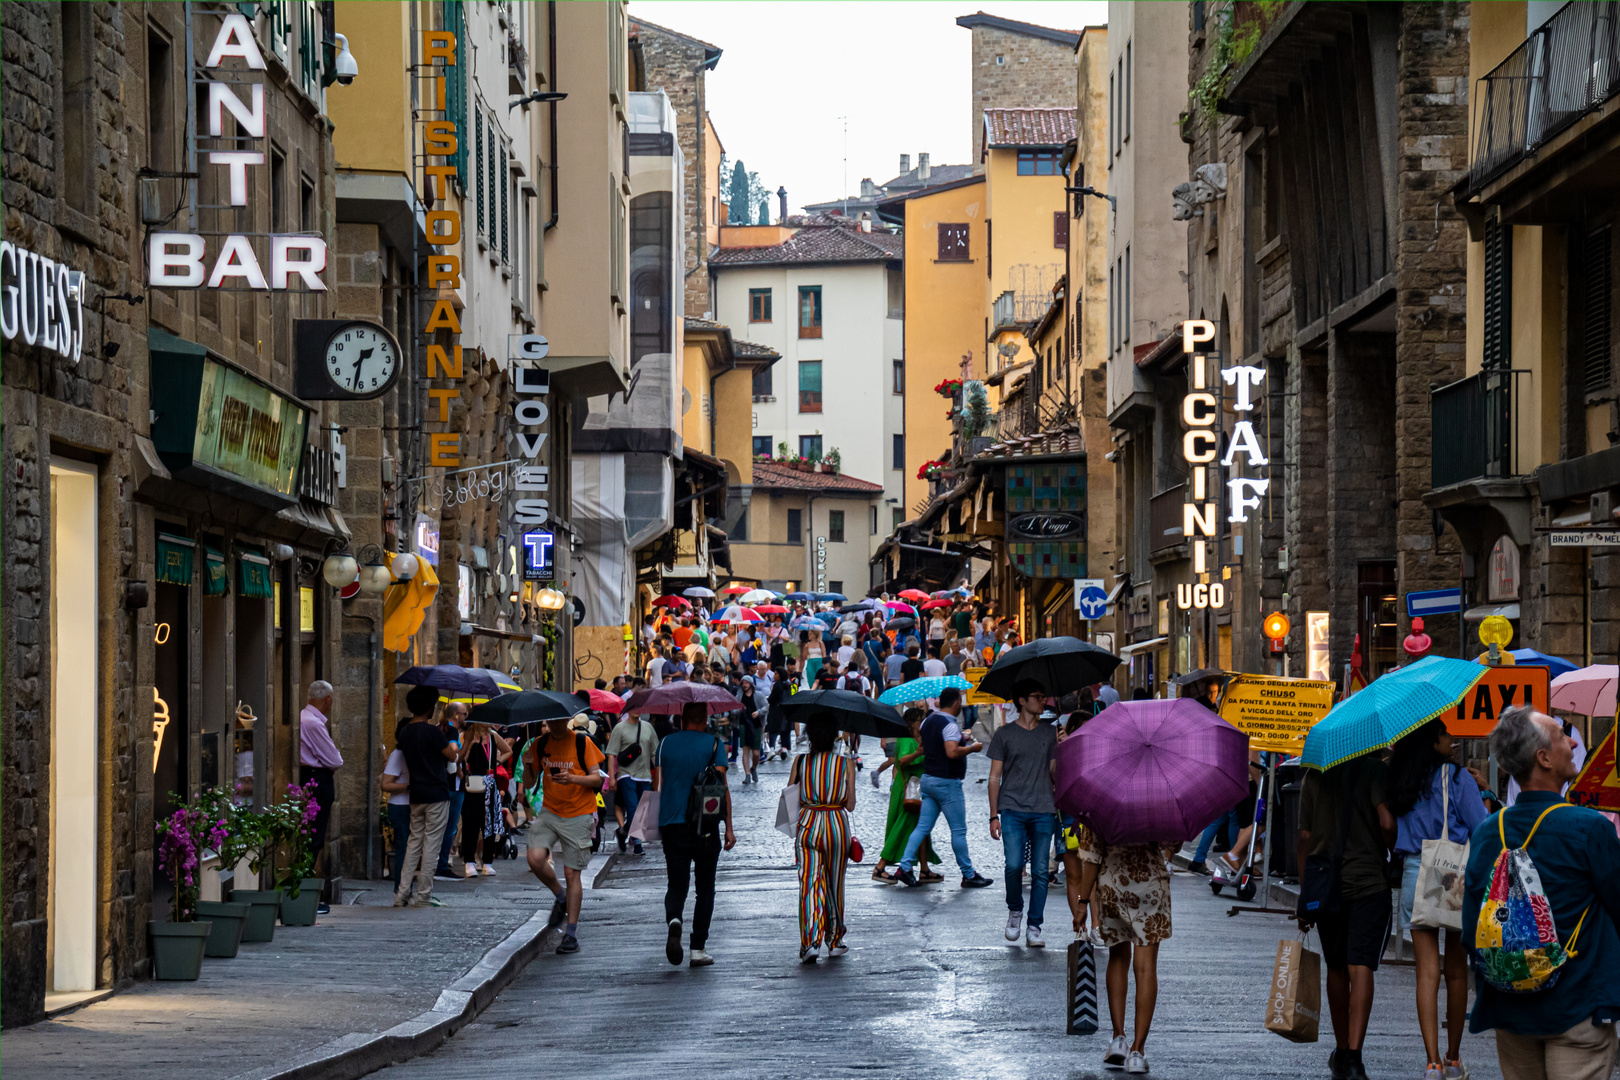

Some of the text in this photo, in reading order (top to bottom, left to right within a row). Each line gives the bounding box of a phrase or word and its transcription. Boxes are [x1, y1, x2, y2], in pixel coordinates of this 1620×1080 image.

[423, 31, 463, 467] RISTORANTE
[150, 233, 327, 290] BAR
[345, 333, 350, 342] 11
[356, 330, 364, 338] 12
[373, 333, 376, 342] 1
[335, 343, 343, 351] 10
[381, 342, 386, 351] 2
[331, 355, 336, 364] 9
[385, 355, 391, 364] 3
[335, 367, 340, 376] 8
[382, 367, 387, 376] 4
[345, 377, 351, 386] 7
[358, 381, 364, 389] 6
[372, 377, 377, 386] 5
[515, 334, 550, 524] GLOVES
[1182, 318, 1216, 574] PICCINI
[1220, 365, 1269, 523] TAF
[1552, 535, 1620, 543] BRANDY MEL
[524, 533, 553, 567] T
[817, 573, 826, 593] FAC
[1177, 583, 1224, 609] UGO
[1260, 689, 1296, 698] CHIUSO
[1239, 698, 1263, 706] PONTE
[1247, 707, 1275, 715] VICOLO
[1276, 945, 1292, 989] ONLINE
[1273, 992, 1285, 1024] SHOP
